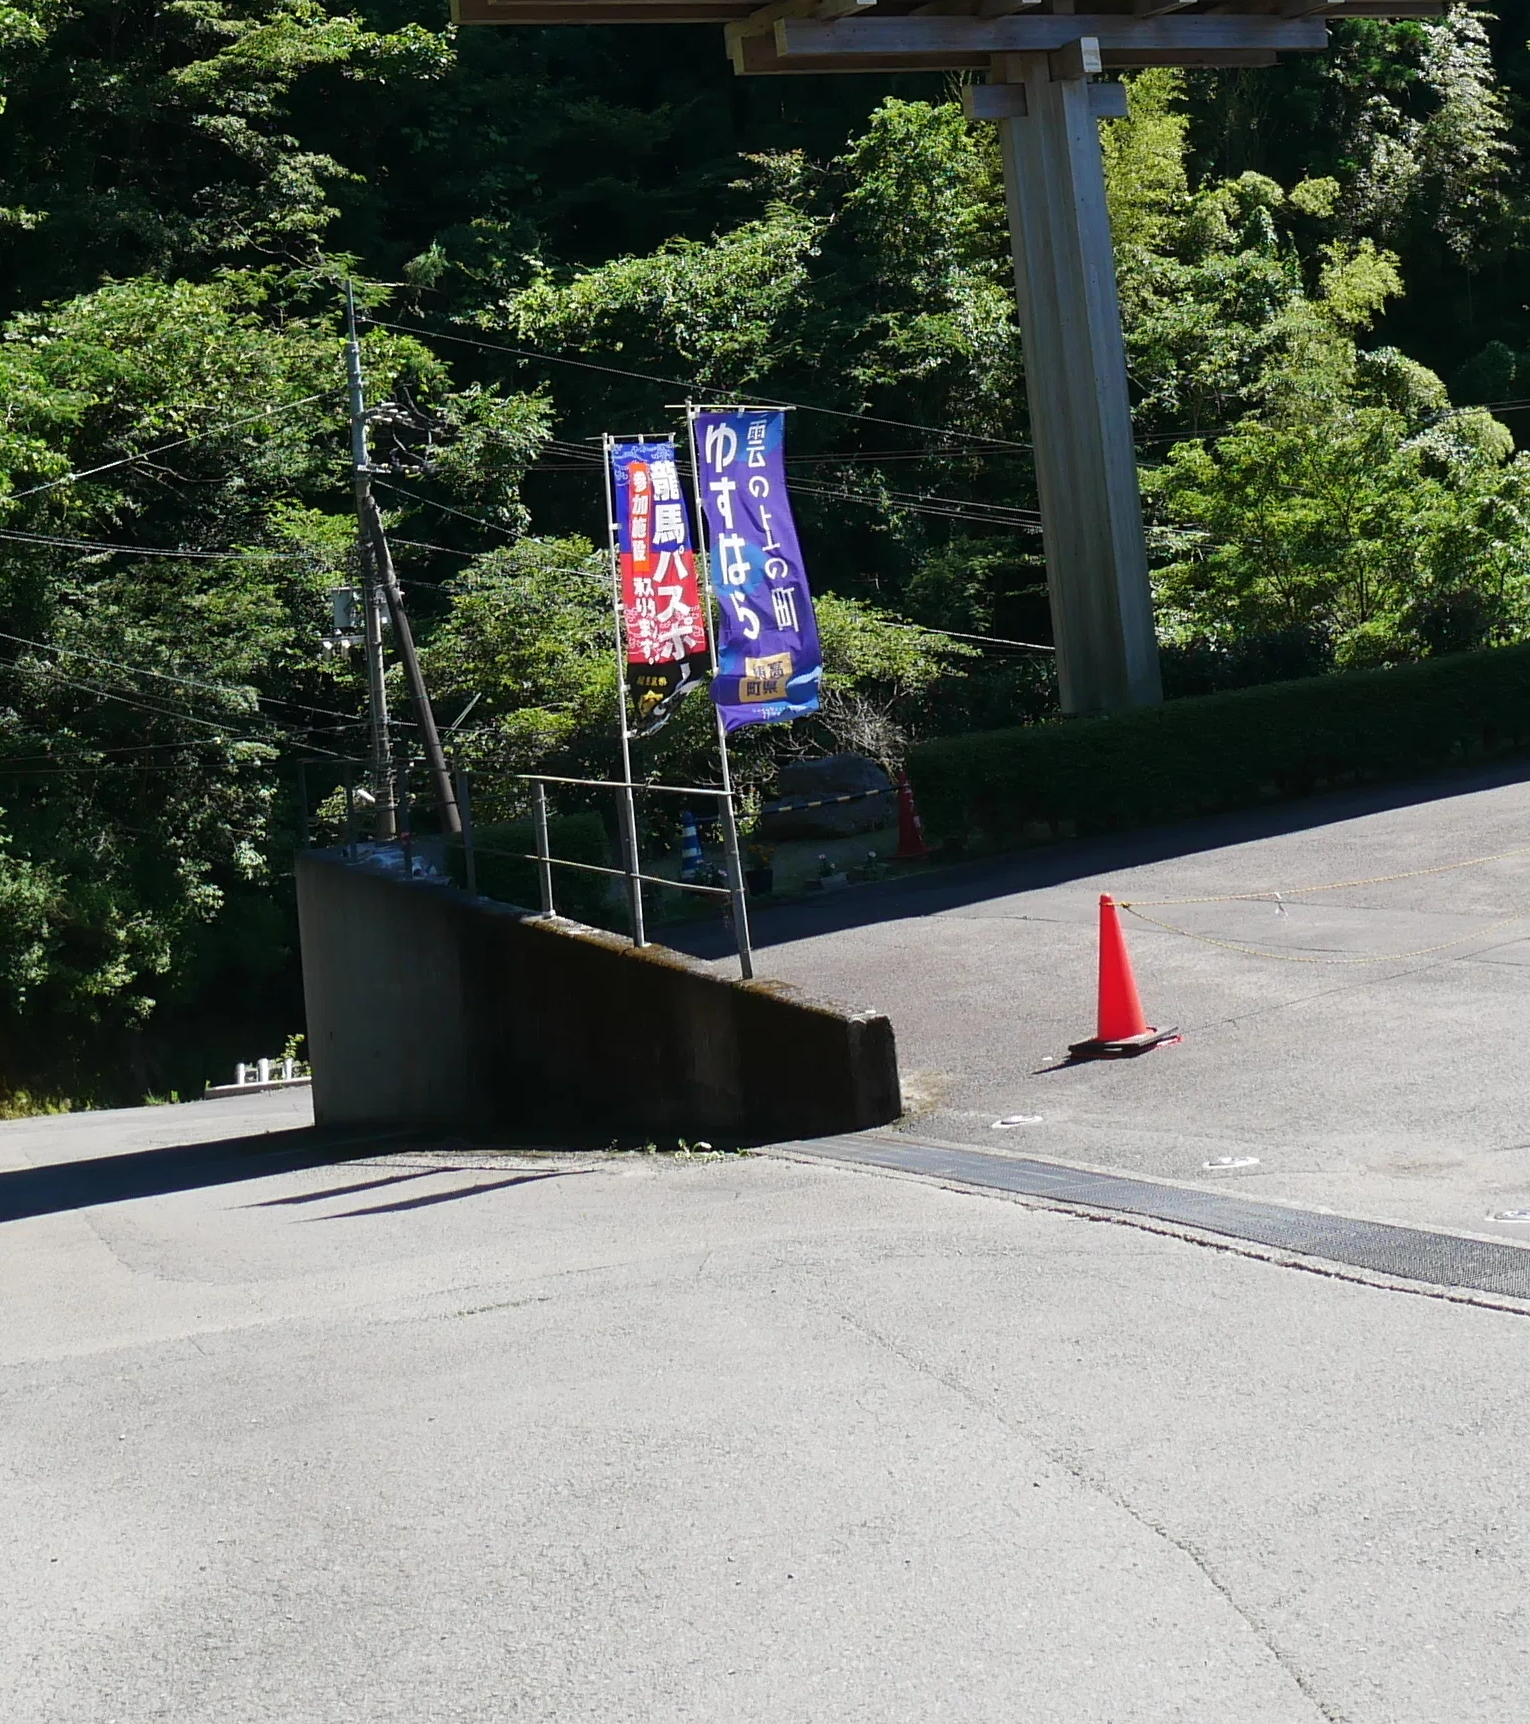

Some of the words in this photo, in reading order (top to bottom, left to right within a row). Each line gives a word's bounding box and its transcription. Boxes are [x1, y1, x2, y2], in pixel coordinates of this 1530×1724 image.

[631, 471, 649, 562] 参加施設
[705, 422, 761, 641] ゆすはら
[746, 419, 799, 633] 雲の上の町
